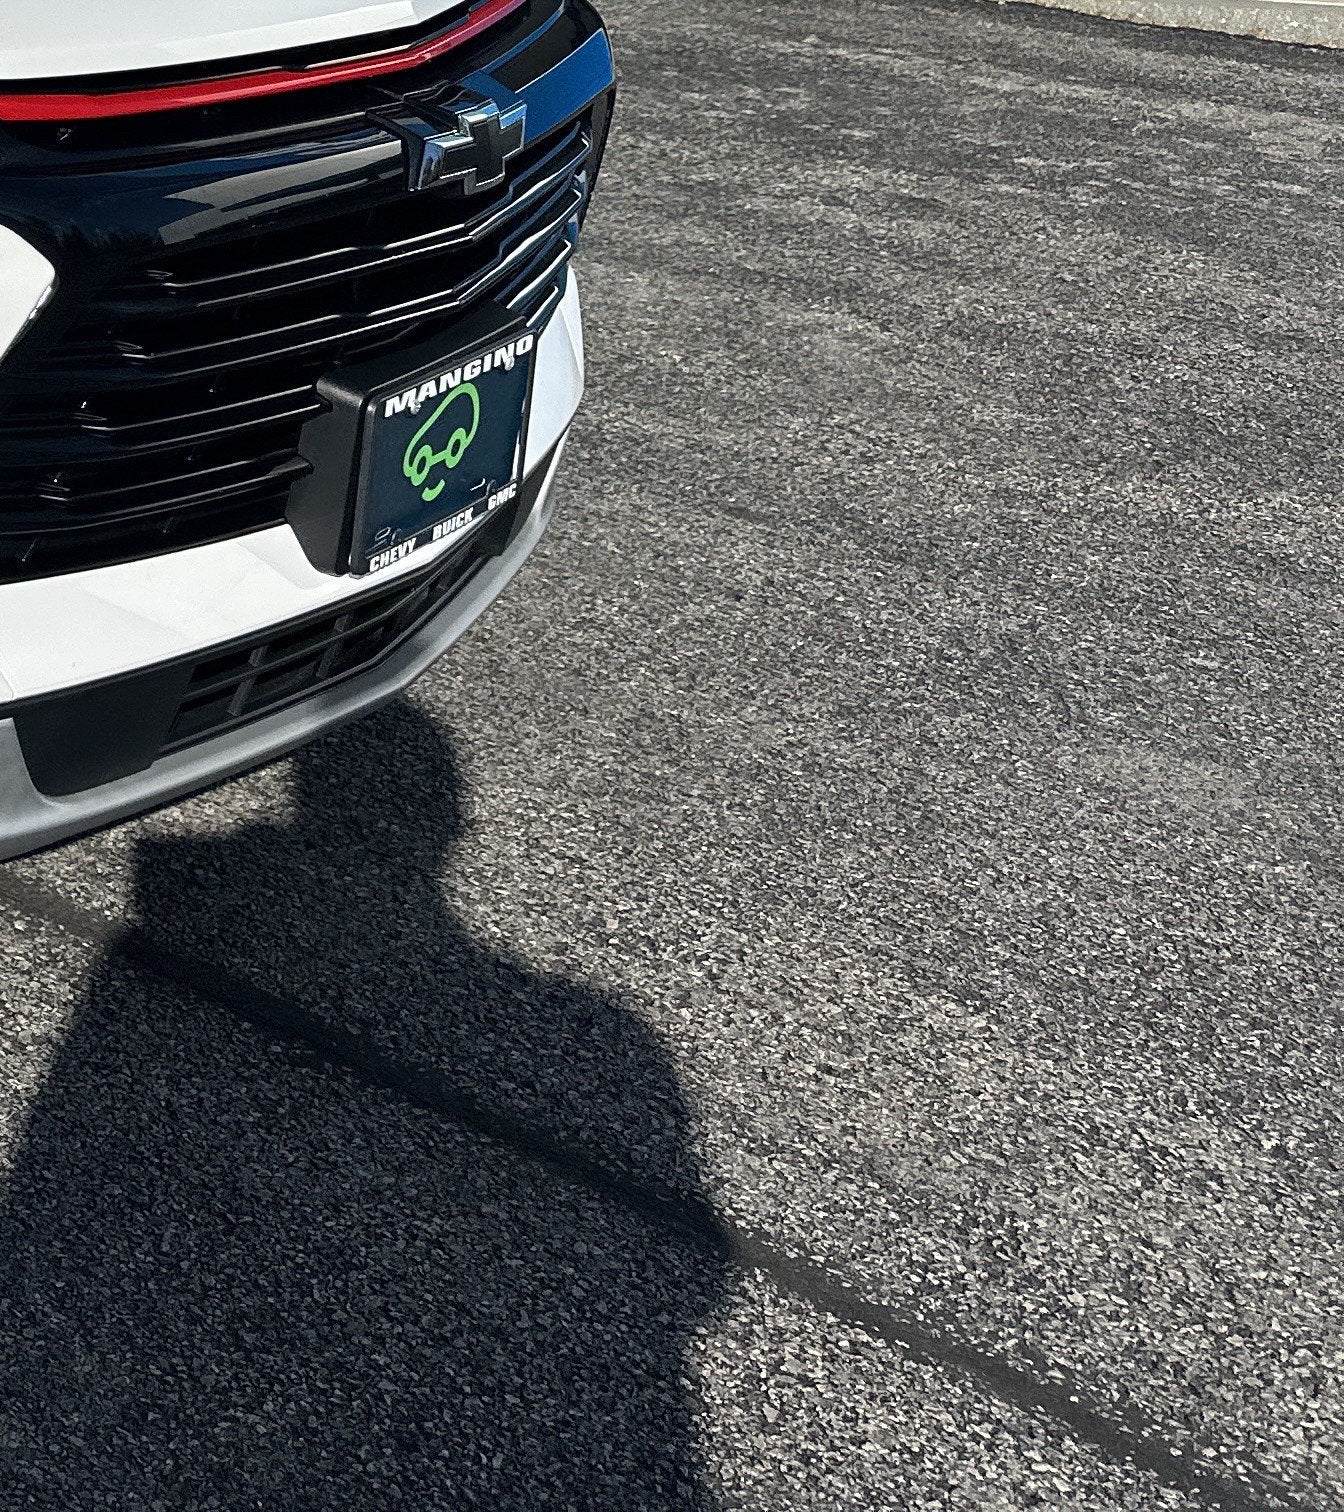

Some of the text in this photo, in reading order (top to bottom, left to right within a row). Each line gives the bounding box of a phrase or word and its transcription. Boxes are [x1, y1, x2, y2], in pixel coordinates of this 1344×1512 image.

[384, 334, 534, 418] MANGINO
[369, 484, 517, 572] CHEVY BUICK GMC
